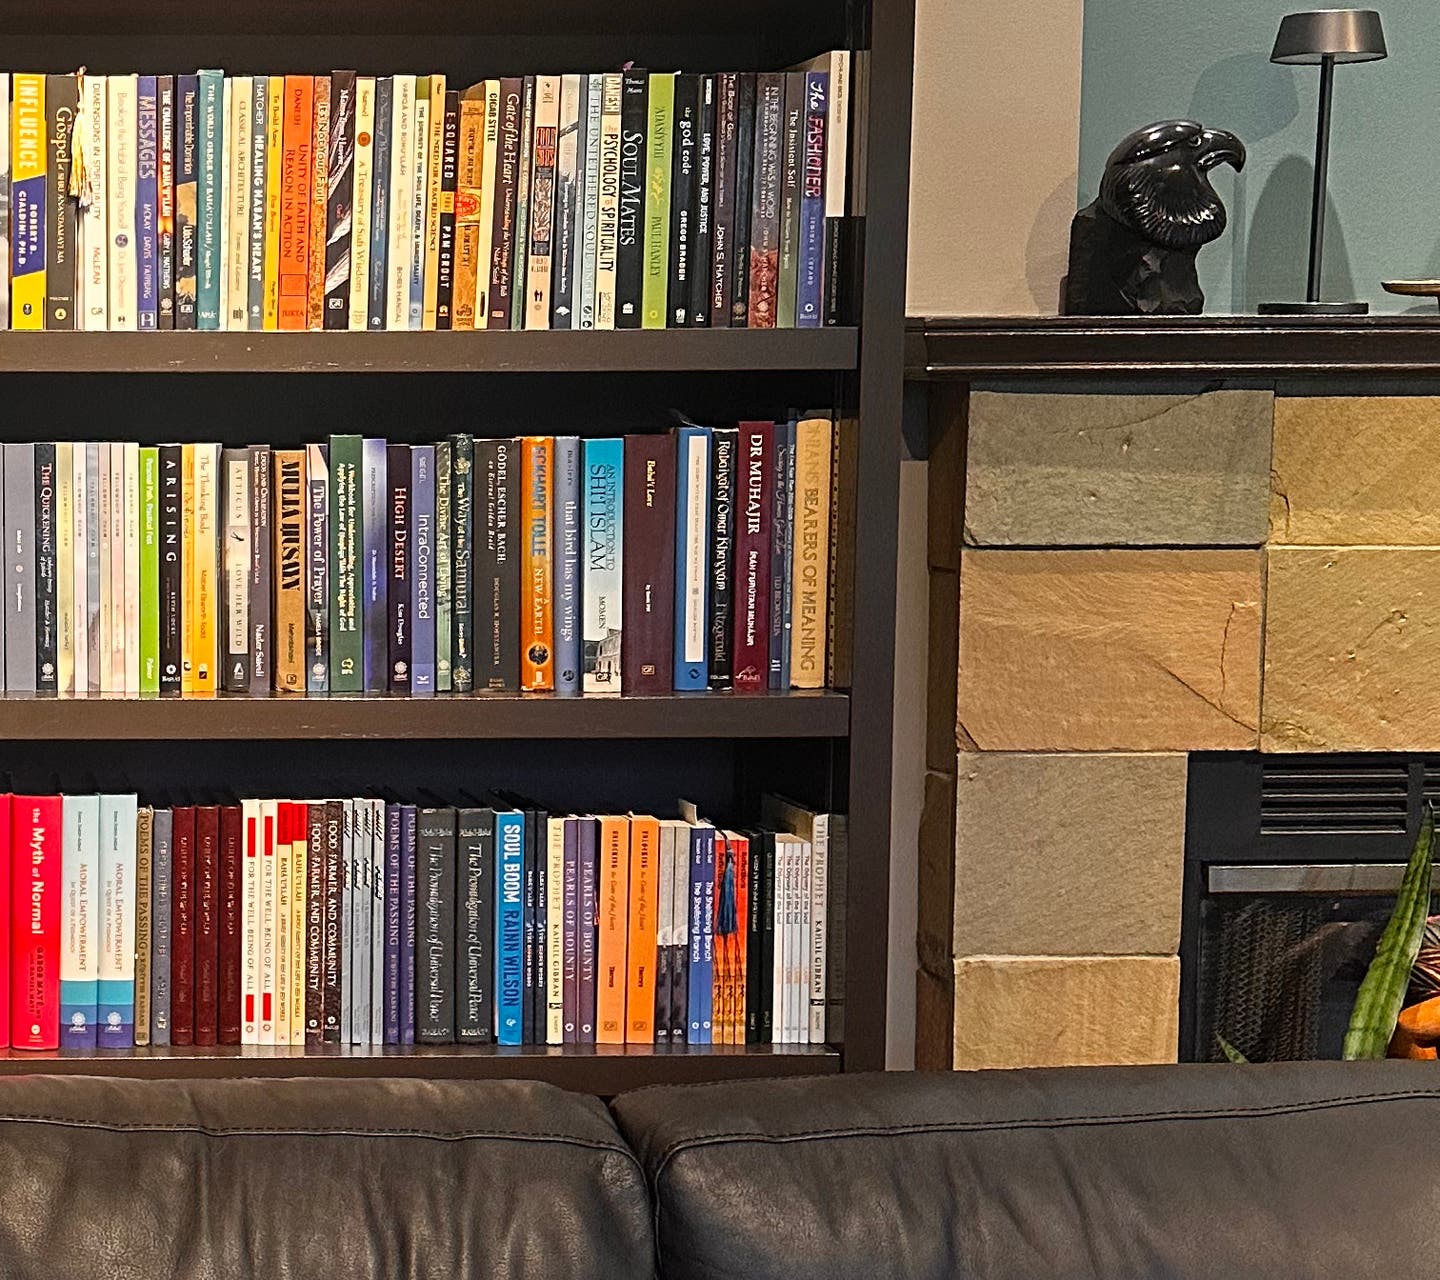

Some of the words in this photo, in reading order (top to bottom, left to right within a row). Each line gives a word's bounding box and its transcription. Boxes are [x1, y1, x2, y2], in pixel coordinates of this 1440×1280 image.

[810, 82, 823, 109] The
[20, 80, 39, 168] INFLUENCE
[137, 96, 156, 179] MESSAGES
[680, 121, 693, 146] god
[681, 150, 692, 174] code
[716, 224, 726, 248] JOHN
[715, 263, 724, 308] HATCHER
[749, 434, 763, 457] DR
[166, 460, 176, 562] ARISING
[313, 486, 324, 509] The
[566, 501, 577, 526] that
[748, 461, 762, 535] MUHAJIR
[313, 512, 324, 547] Power
[566, 530, 577, 555] bird
[590, 511, 605, 571] ISLAM
[803, 488, 818, 562] BEARERS
[311, 565, 325, 604] Prayer
[417, 515, 431, 619] IntraConnected
[565, 559, 576, 580] has
[802, 565, 816, 587] OF
[562, 584, 573, 602] my
[562, 605, 577, 641] wings
[801, 591, 816, 671] MEANING
[32, 808, 40, 823] the
[30, 827, 44, 864] Myth
[504, 864, 520, 902] BOOM
[31, 881, 44, 934] Normal
[504, 910, 520, 951] RAINN
[503, 956, 519, 1006] WILSON
